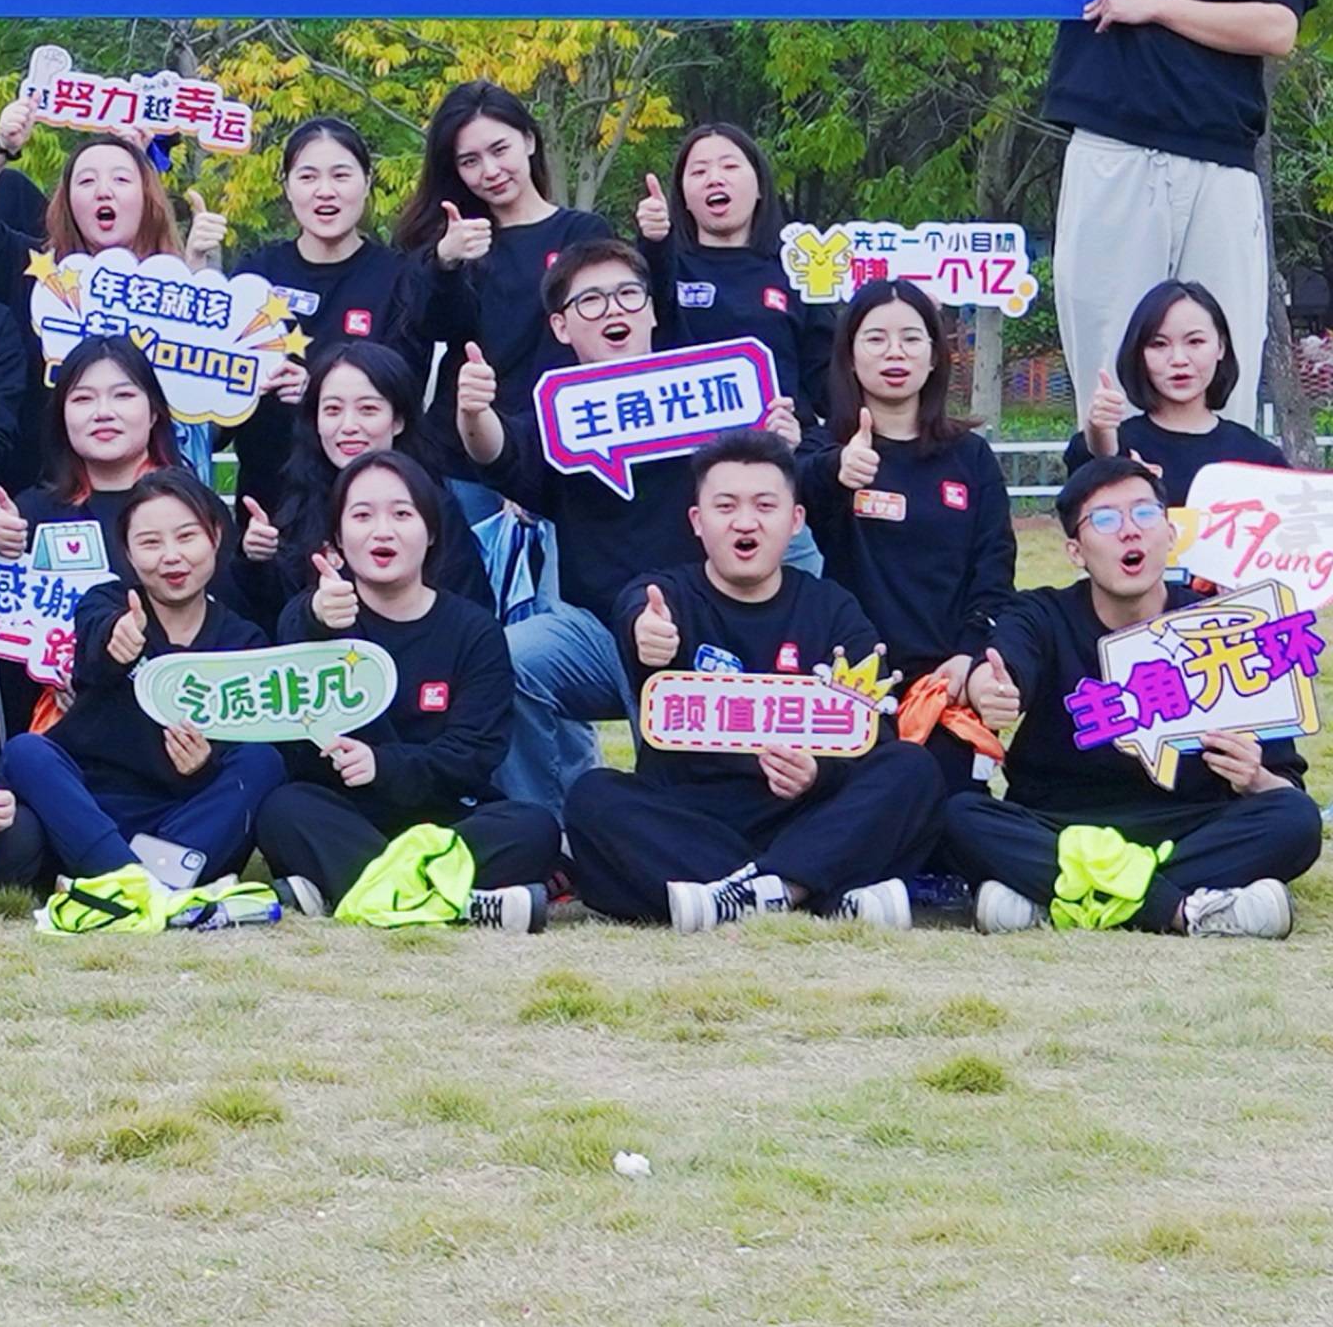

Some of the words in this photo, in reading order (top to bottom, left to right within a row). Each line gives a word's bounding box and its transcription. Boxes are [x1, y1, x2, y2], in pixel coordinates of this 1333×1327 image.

[854, 231, 1017, 252] 先立一个小目标
[90, 266, 233, 330] 年轻就该
[571, 372, 744, 440] 主角光环
[178, 665, 365, 723] 气质非凡
[1063, 609, 1327, 752] 主角光环
[662, 693, 856, 735] 颜值担当
